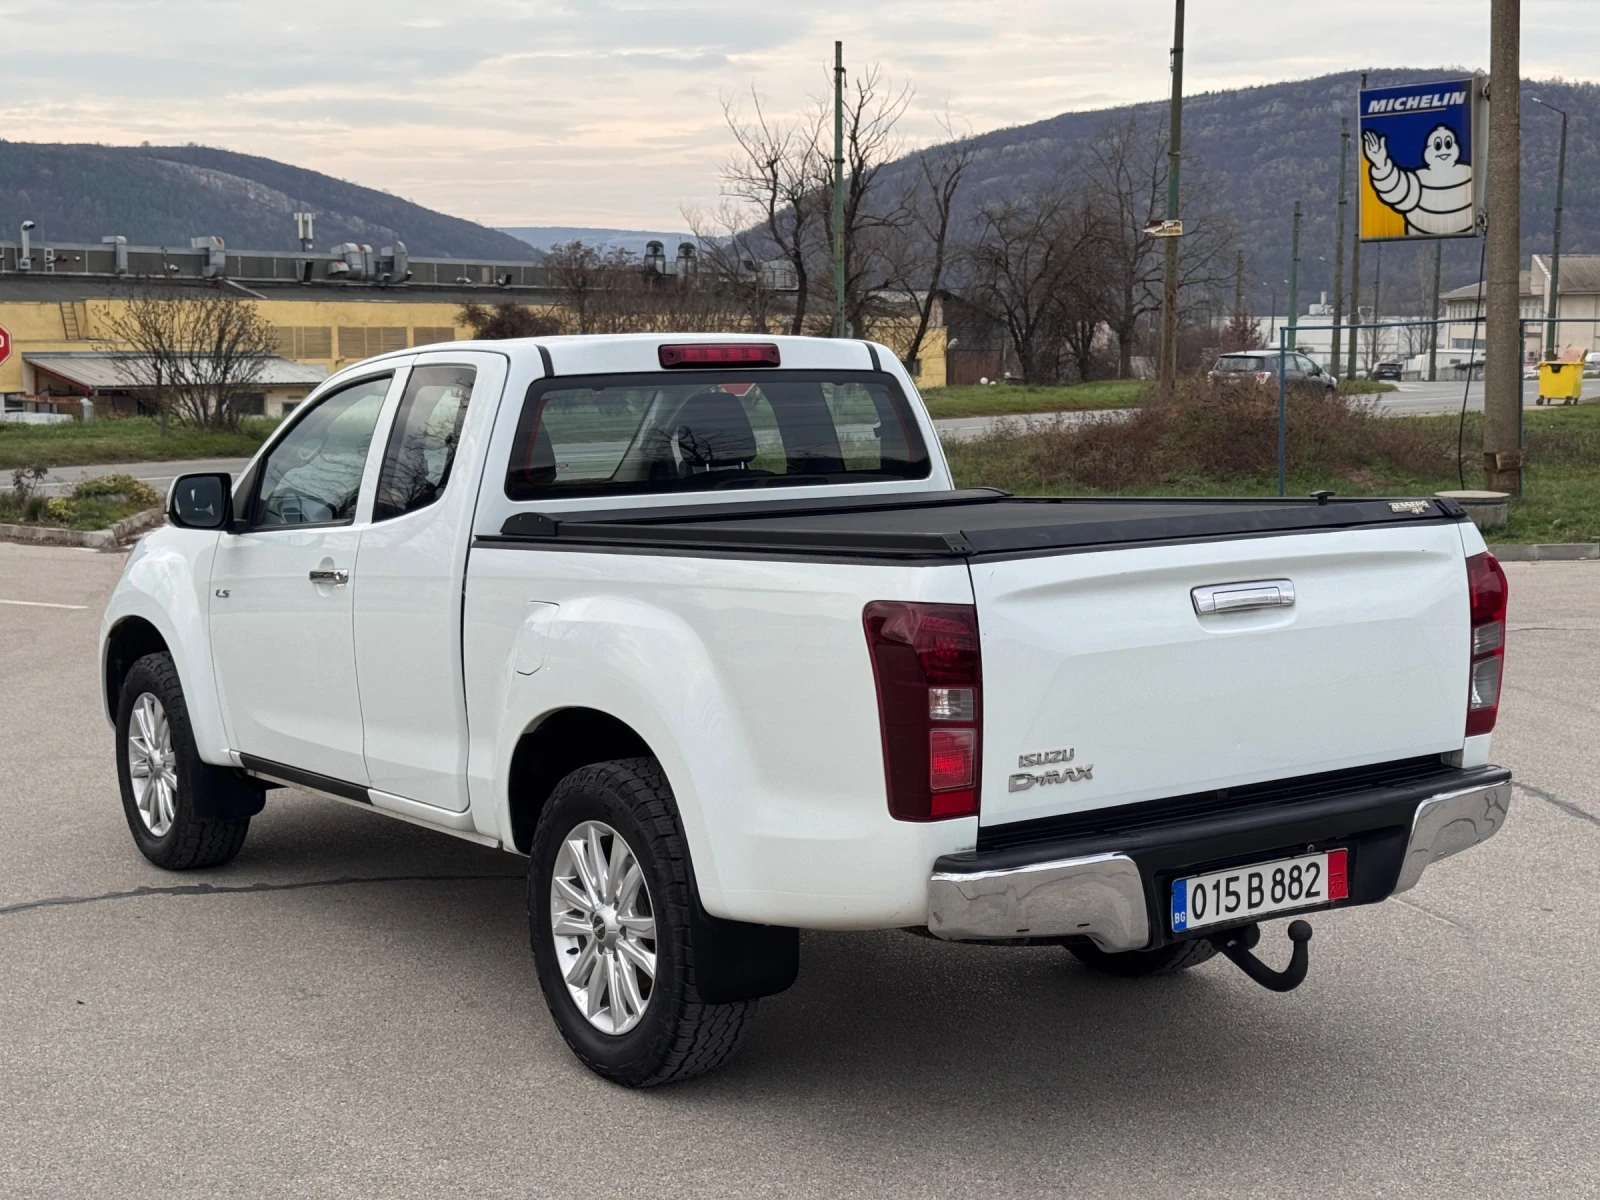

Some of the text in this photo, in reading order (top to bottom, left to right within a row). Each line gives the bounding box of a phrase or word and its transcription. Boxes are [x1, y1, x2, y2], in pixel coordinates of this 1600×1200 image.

[1368, 91, 1466, 114] MICHELIN
[215, 589, 231, 598] LS
[1018, 747, 1075, 769] ISUZU
[1191, 861, 1321, 920] 015 B 882
[1174, 911, 1186, 925] BG
